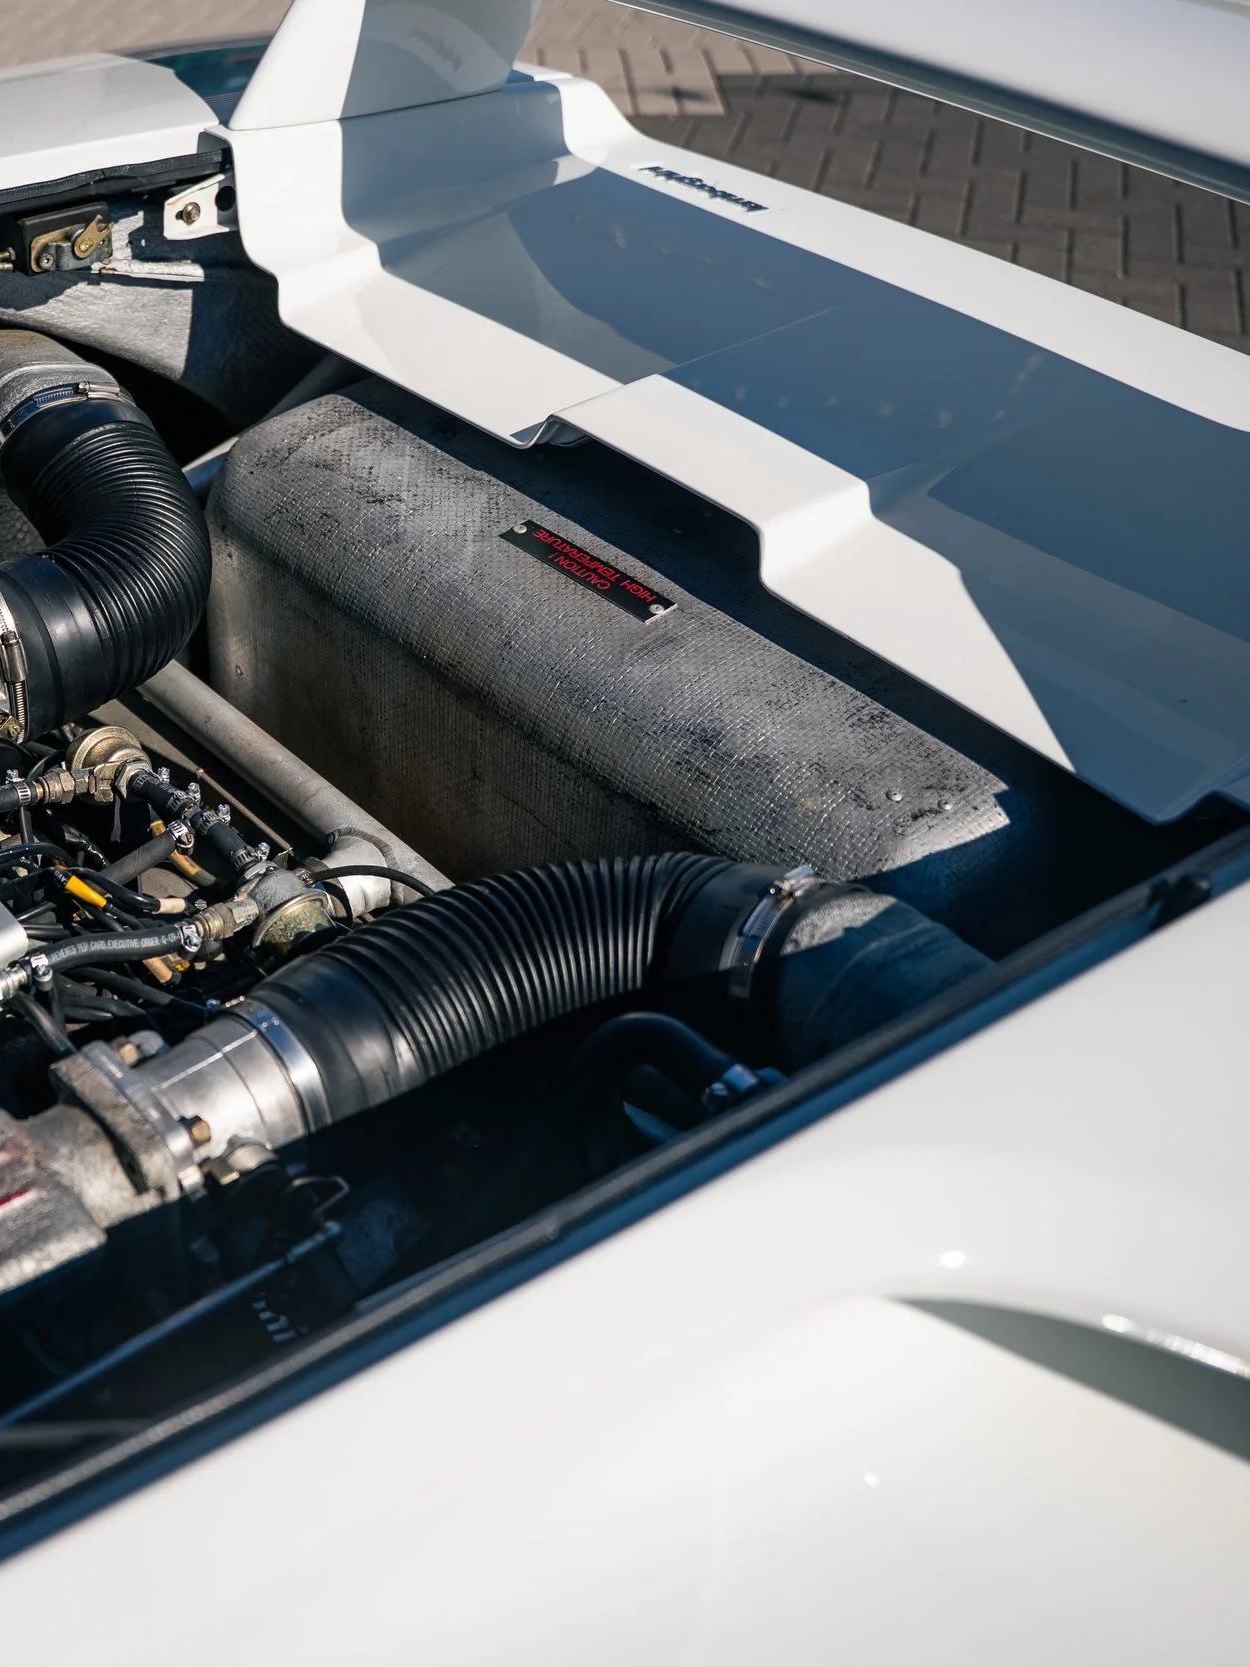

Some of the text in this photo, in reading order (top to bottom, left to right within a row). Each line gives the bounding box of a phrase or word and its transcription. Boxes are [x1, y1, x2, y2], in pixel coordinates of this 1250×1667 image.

[533, 528, 657, 603] HIGH TEMPERATURE
[554, 555, 611, 591] CAUTION
[106, 938, 140, 950] EXECUTIVE
[140, 936, 160, 948] ORDER
